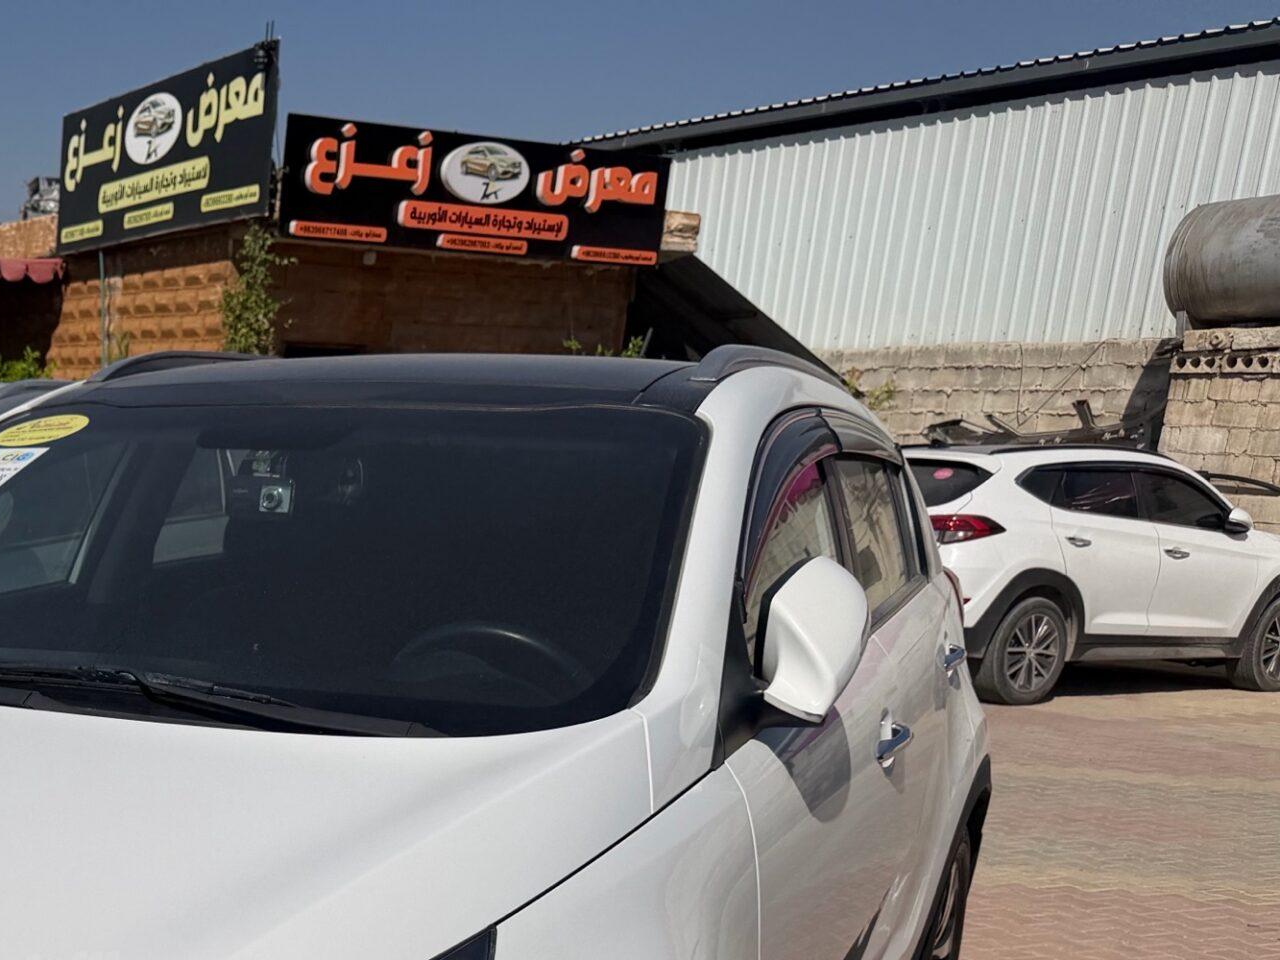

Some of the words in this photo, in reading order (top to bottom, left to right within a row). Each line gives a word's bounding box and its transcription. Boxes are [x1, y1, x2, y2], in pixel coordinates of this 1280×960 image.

[186, 72, 265, 147] معرض
[537, 149, 658, 213] معرض
[449, 211, 490, 229] السيارات
